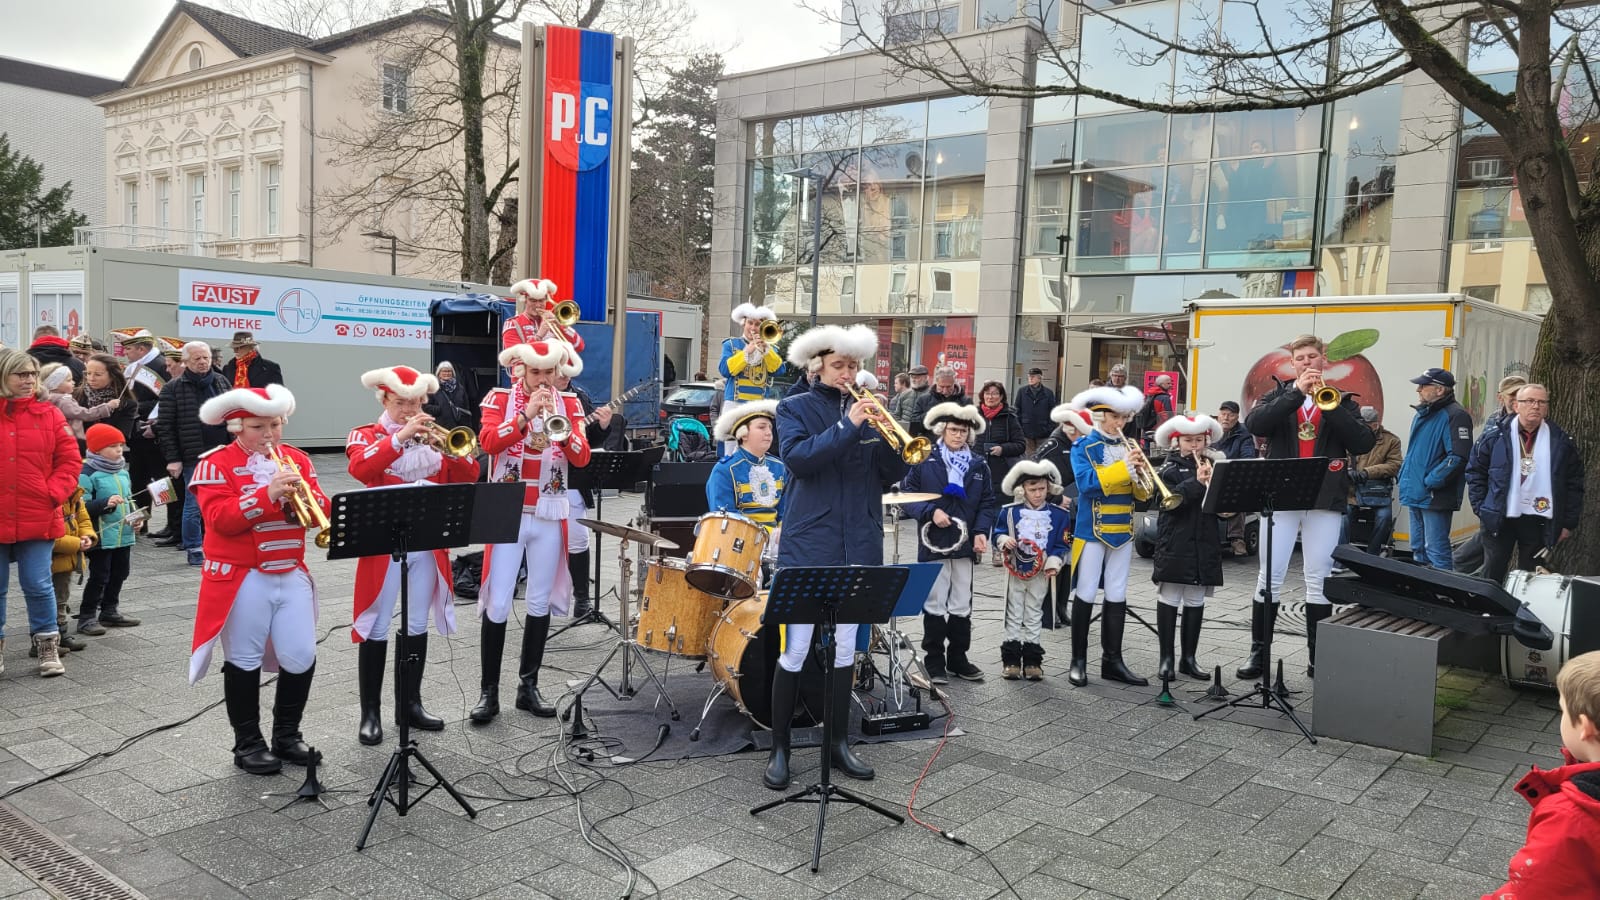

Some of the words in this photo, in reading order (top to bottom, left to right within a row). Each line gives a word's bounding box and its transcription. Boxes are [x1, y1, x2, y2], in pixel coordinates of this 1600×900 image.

[194, 286, 254, 305] FAUST
[358, 295, 427, 307] ÖFFNUNGSZEITEN
[192, 316, 262, 330] APOTHEKE
[373, 326, 405, 338] 02403
[947, 351, 968, 359] SALE
[877, 360, 889, 368] 50%
[947, 361, 968, 370] 50%
